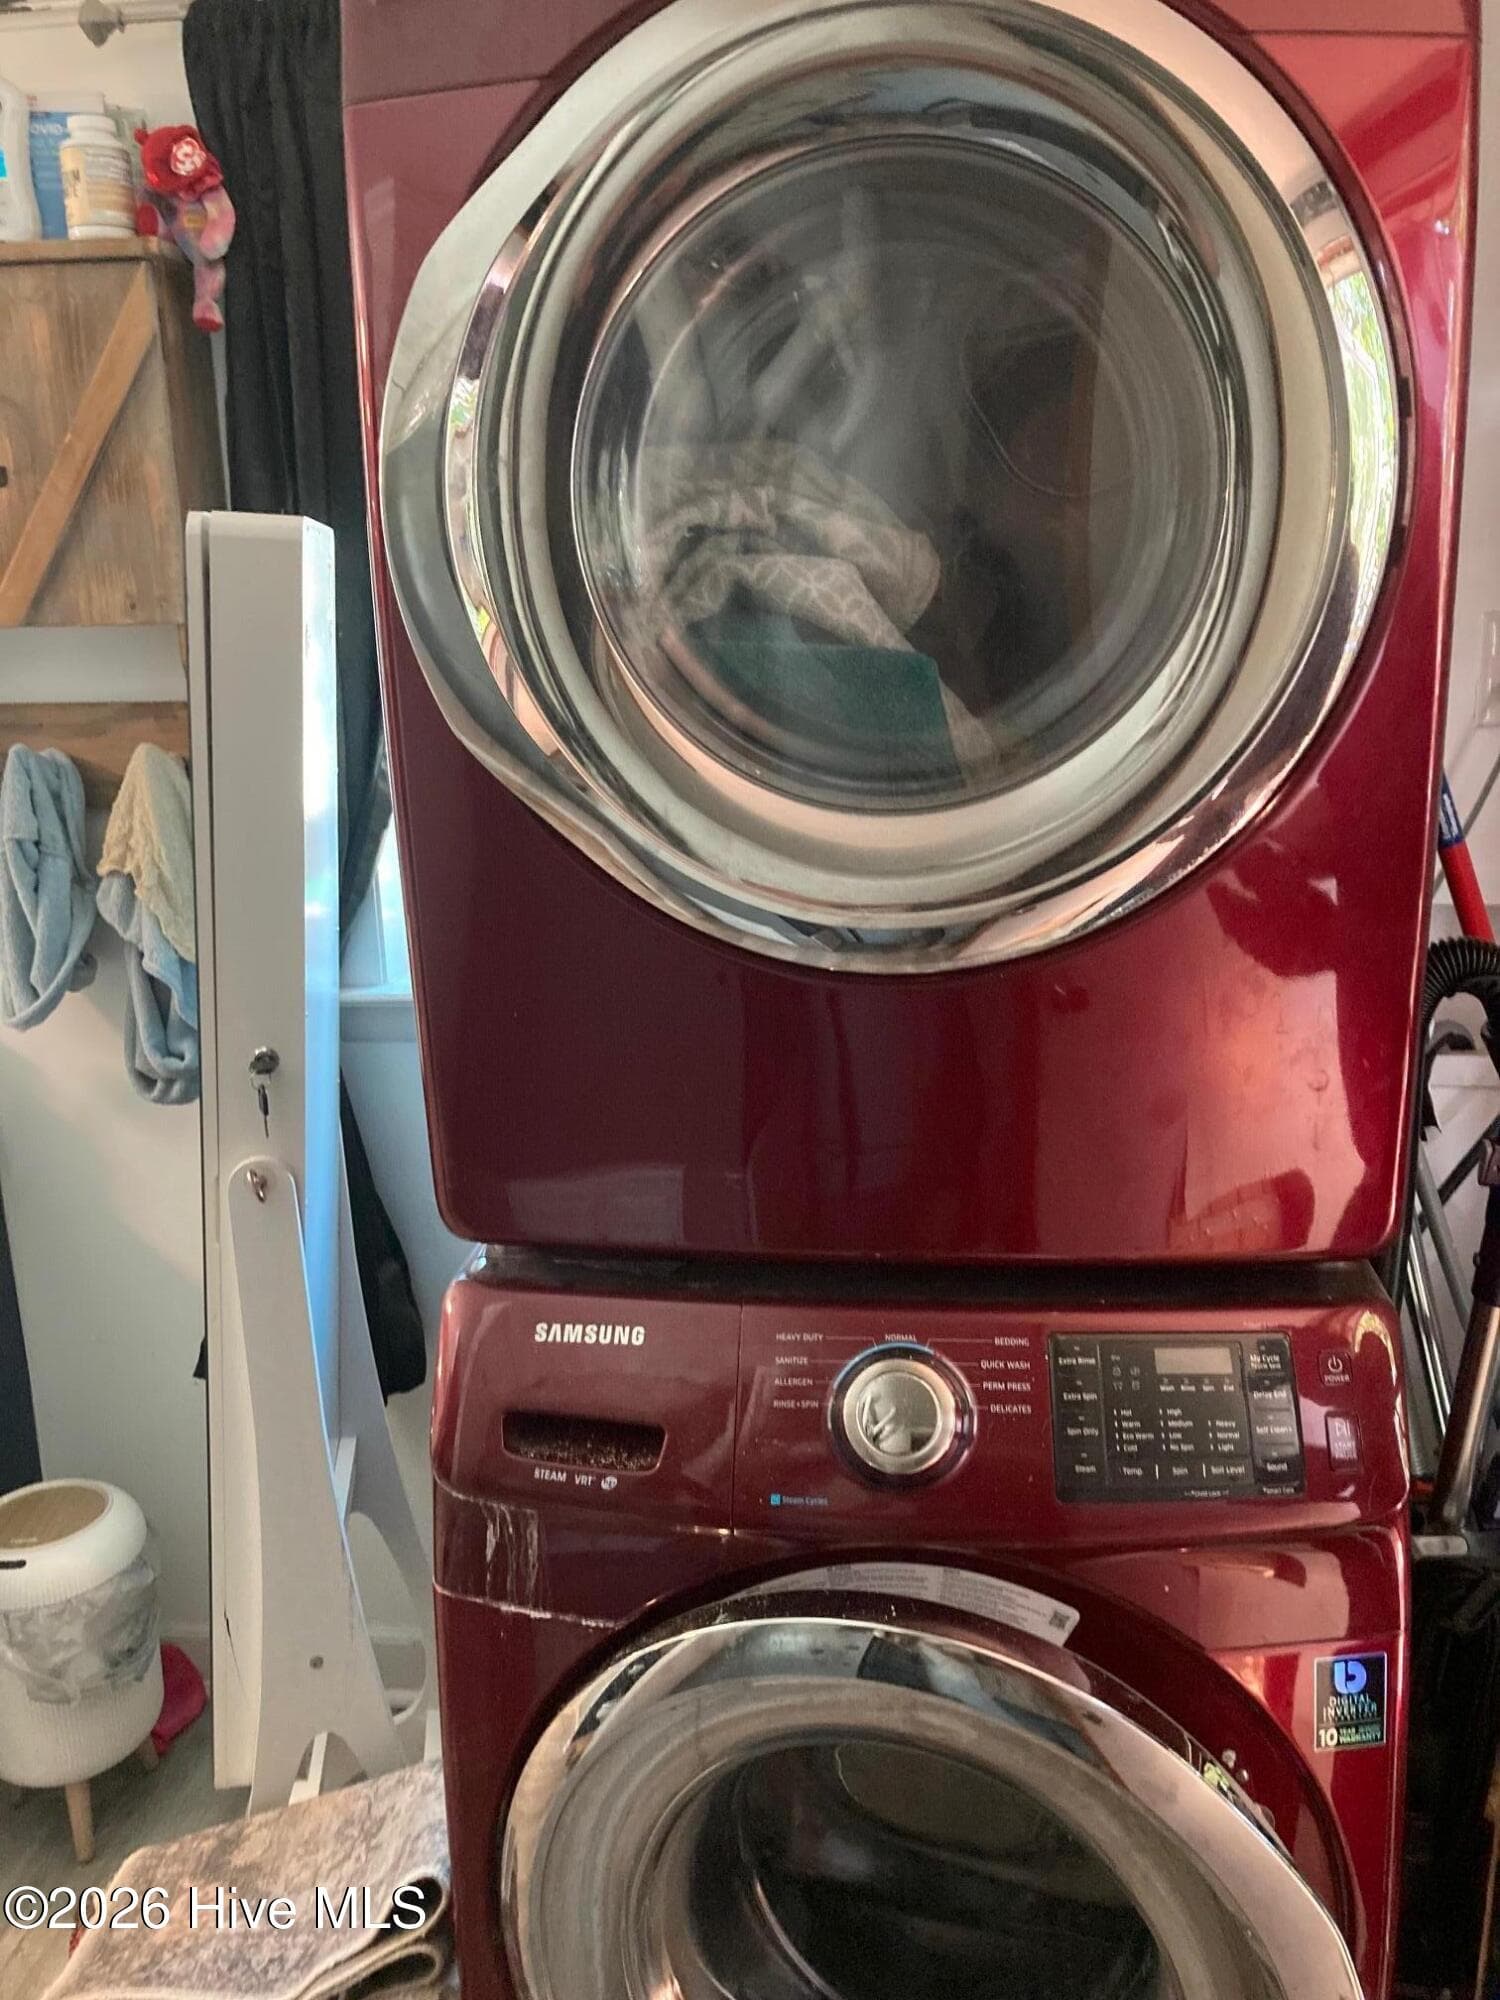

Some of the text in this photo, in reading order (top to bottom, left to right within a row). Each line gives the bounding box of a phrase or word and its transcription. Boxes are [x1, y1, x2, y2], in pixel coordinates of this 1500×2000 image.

[534, 1322, 646, 1346] SAMSUNG
[776, 1332, 823, 1341] HEAVY DUTY
[885, 1333, 917, 1343] NORMAL
[994, 1336, 1030, 1347] BEDDING
[775, 1356, 809, 1365] SANITIZE
[1059, 1356, 1077, 1366] Extra
[1262, 1353, 1281, 1362] Cycle
[981, 1359, 1031, 1371] QUICK WASH
[774, 1377, 814, 1386] ALLERGEN
[1324, 1374, 1350, 1383] POWER
[982, 1381, 1031, 1392] PERM PRESS
[1063, 1392, 1082, 1401] Extra
[1253, 1391, 1273, 1400] Delay
[990, 1403, 1032, 1415] DELICATES
[1217, 1432, 1240, 1440] Normal
[534, 1467, 567, 1483] STEAM
[1226, 1465, 1245, 1475] Level
[1329, 1693, 1371, 1707] DIGITAL
[1323, 1702, 1378, 1721] INVERTER
[1319, 1727, 1338, 1747] 10
